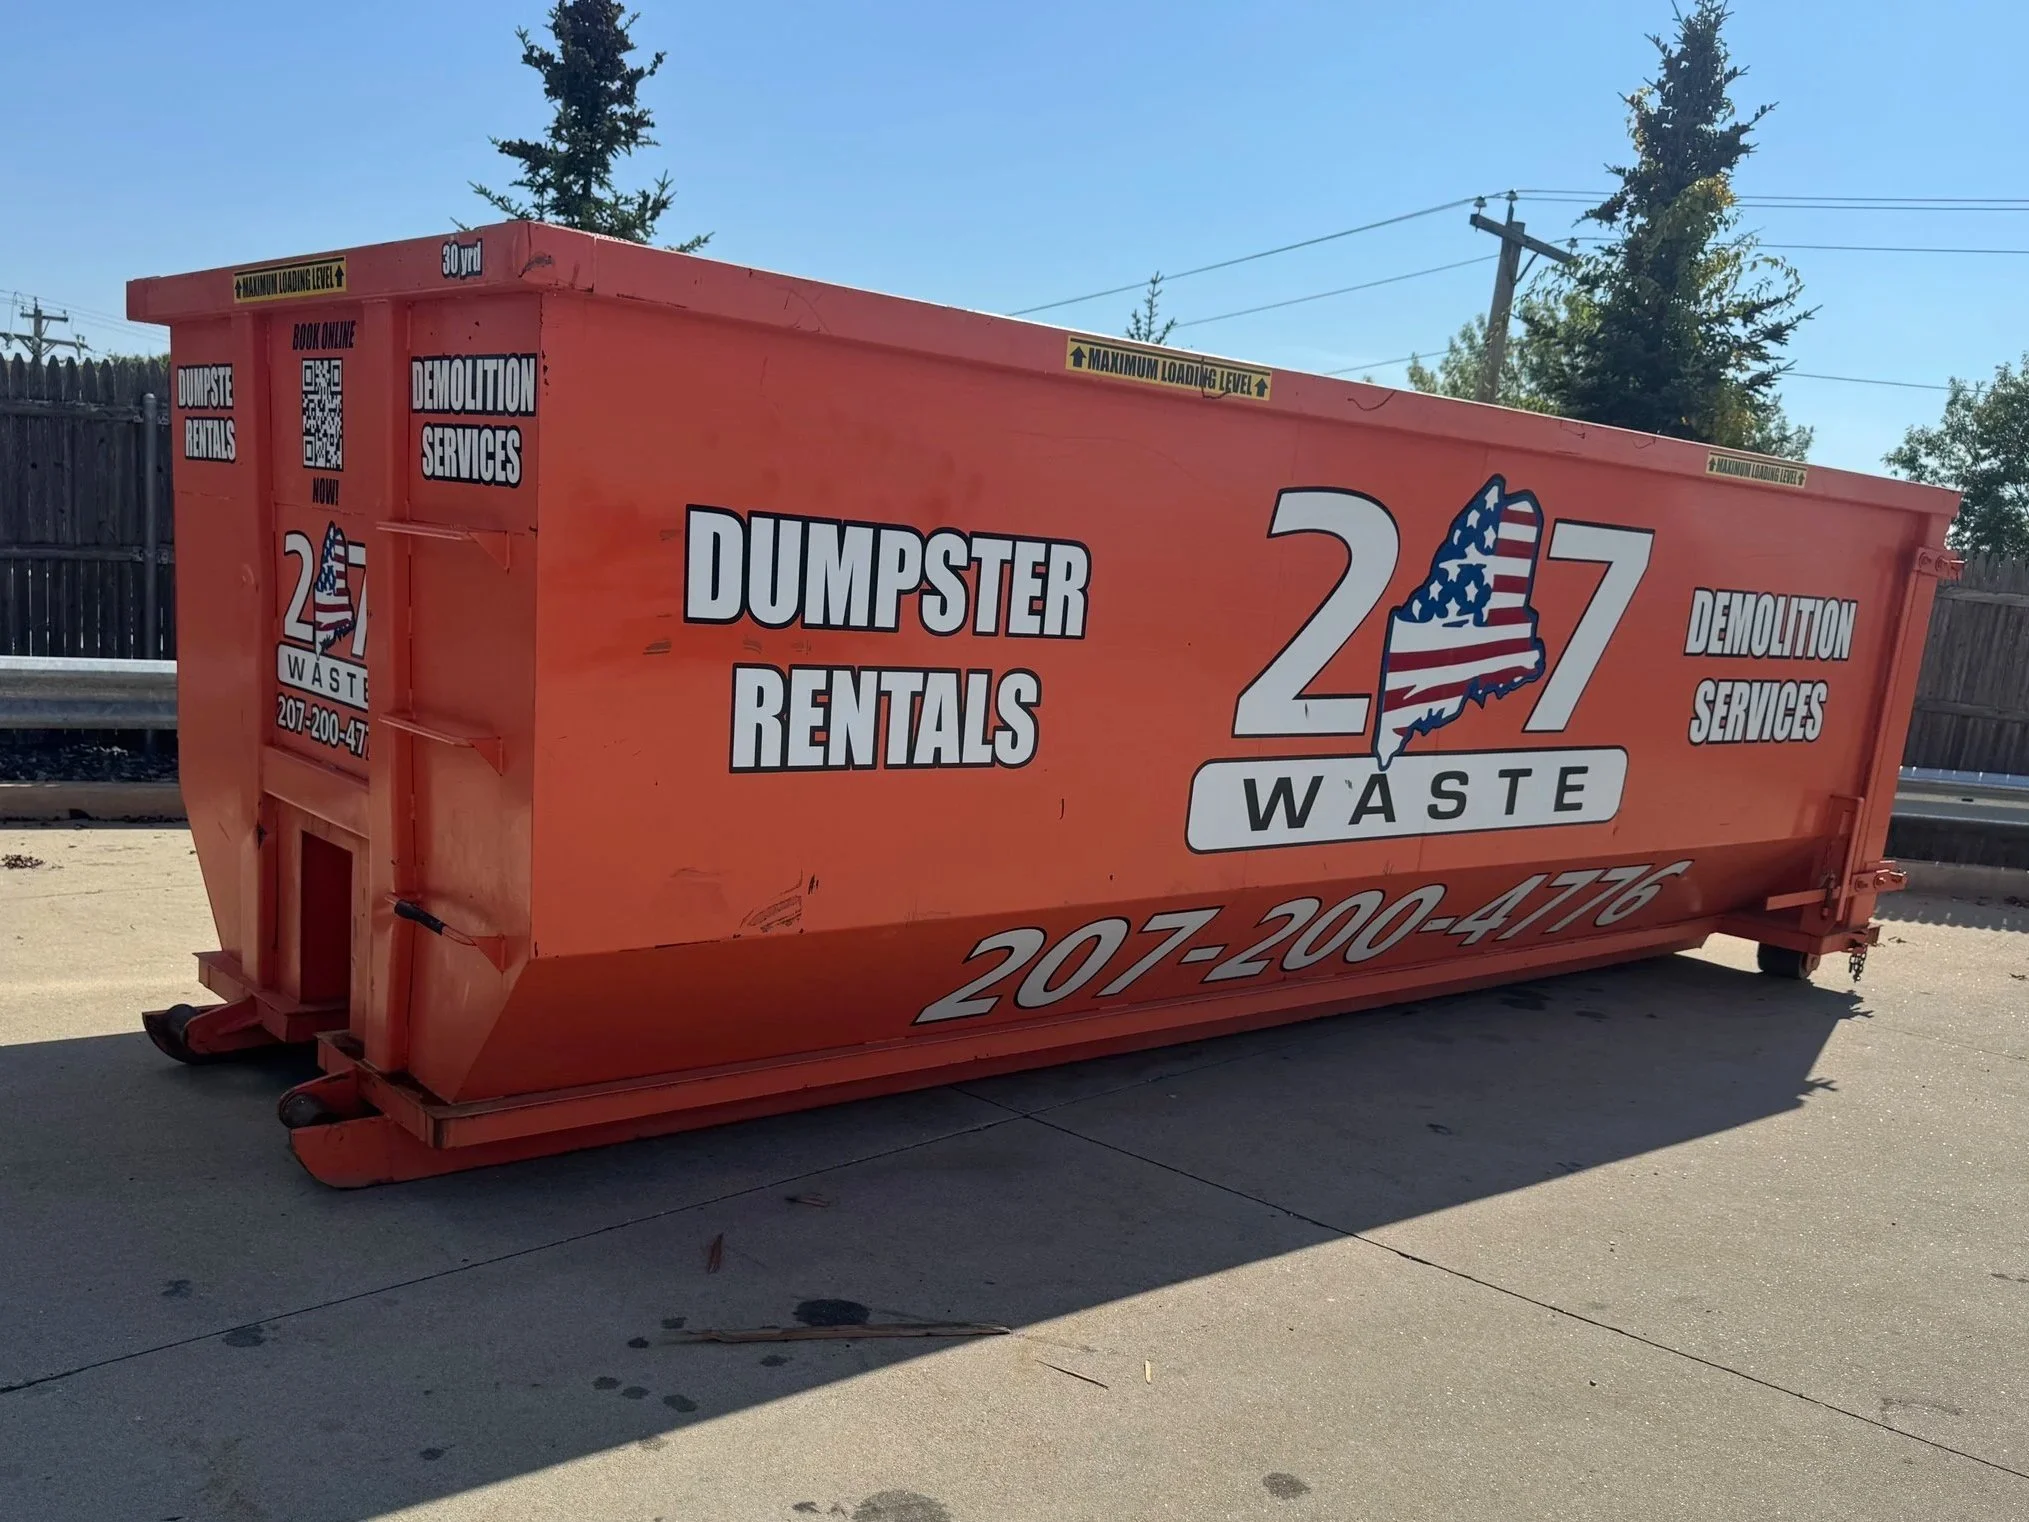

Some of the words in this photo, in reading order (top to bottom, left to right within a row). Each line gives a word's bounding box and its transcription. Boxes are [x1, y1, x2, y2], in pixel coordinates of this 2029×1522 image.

[242, 272, 278, 298] MAXIMUM
[279, 268, 311, 294] LOADING
[312, 265, 335, 290] LEVEL
[441, 240, 459, 278] 30
[460, 238, 483, 279] yrd
[292, 322, 320, 351] BOOK
[321, 320, 356, 350] ONLINE
[410, 353, 537, 417] DEMOLITION
[1088, 347, 1159, 380] MAXIMUM
[1161, 360, 1217, 389] LOADING
[1219, 370, 1253, 395] LEVEL
[184, 415, 237, 464] RENTALS
[421, 422, 522, 488] SERVICES
[1715, 457, 1752, 478] MAXIMUM
[1751, 463, 1780, 483] LOADING
[1779, 468, 1798, 485] LEVEL
[312, 477, 339, 506] NOW!
[684, 504, 1091, 639] DUMPSTER
[1683, 587, 1858, 661] DEMOLITION
[277, 692, 369, 761] 207-200-47
[729, 663, 1042, 773] RENTALS
[1688, 678, 1828, 745] SERVICES
[1242, 765, 1589, 832] WASTE
[911, 859, 1695, 1028] 207-200-4776
